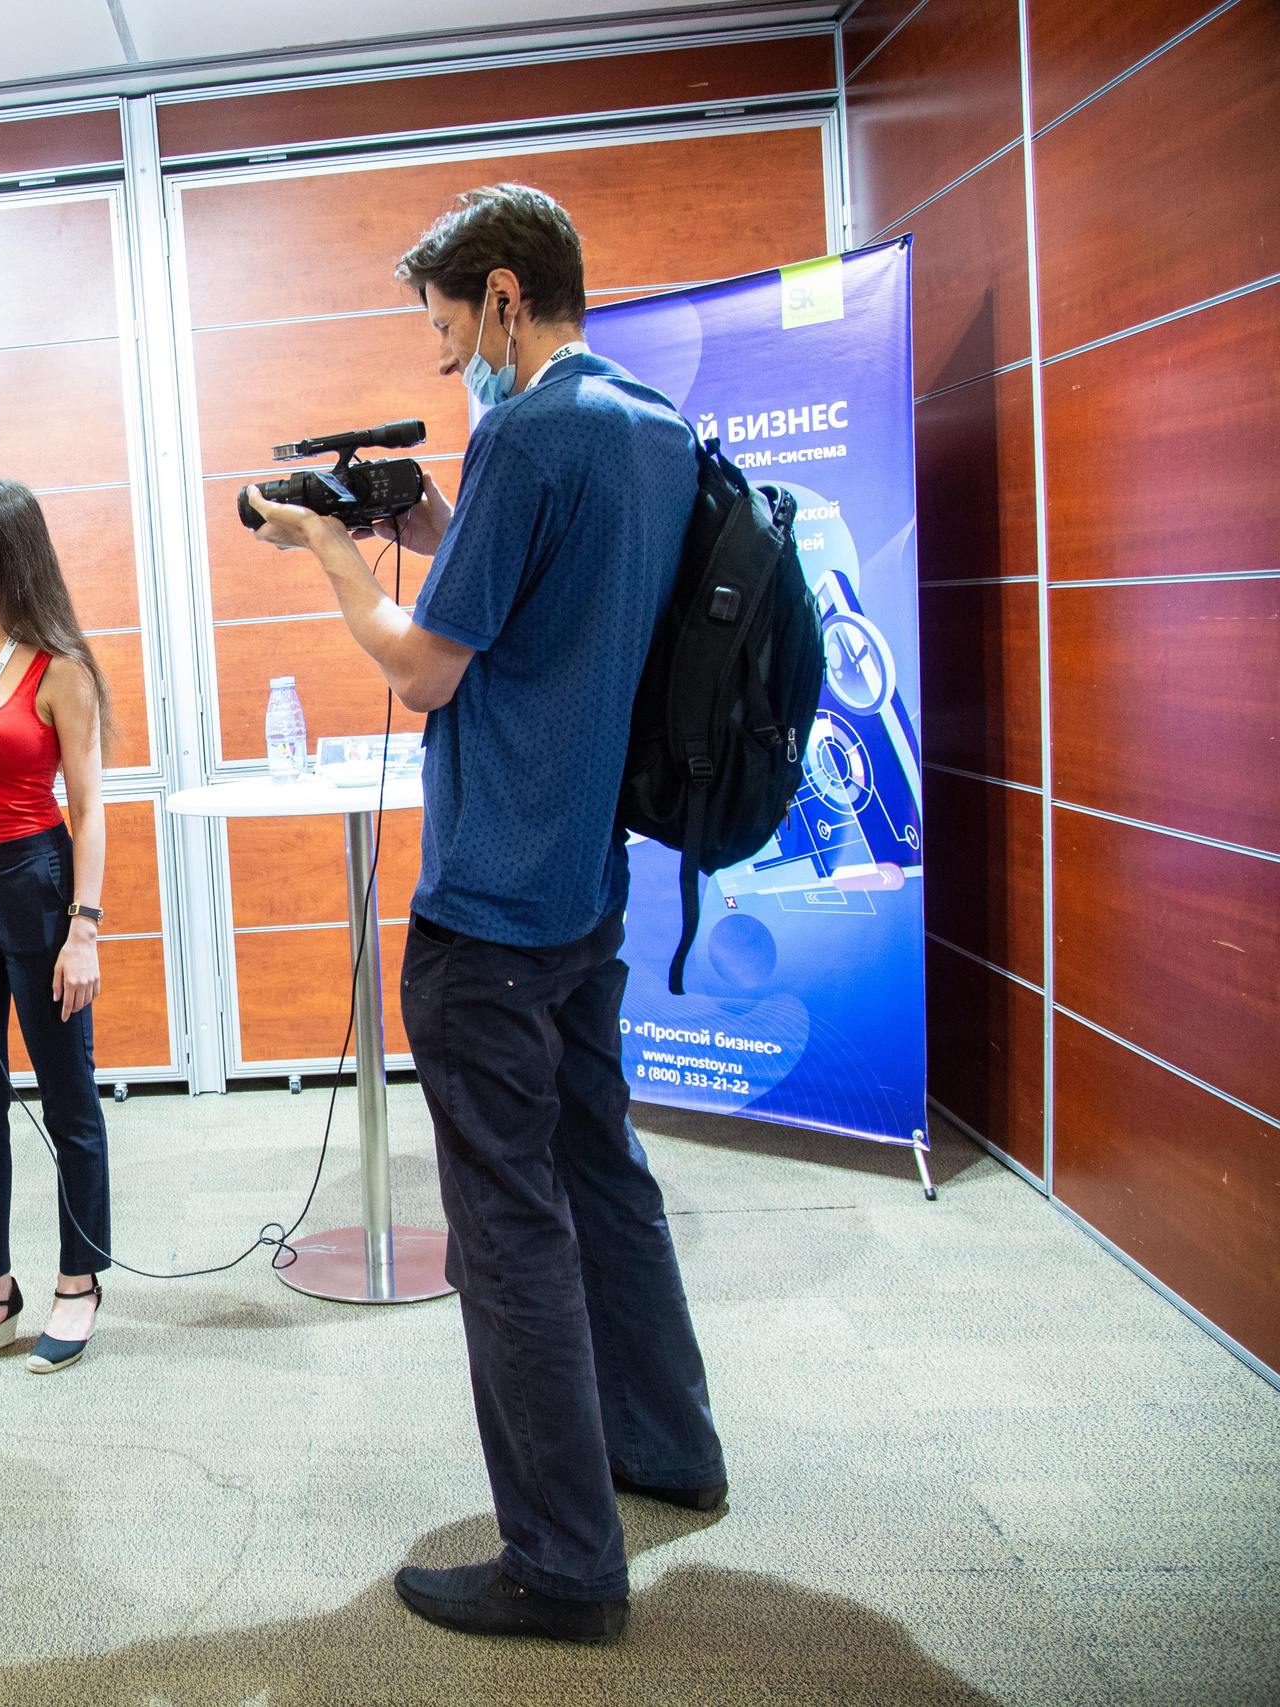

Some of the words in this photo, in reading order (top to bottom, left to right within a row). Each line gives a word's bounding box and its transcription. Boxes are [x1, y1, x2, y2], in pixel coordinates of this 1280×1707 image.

[789, 287, 816, 311] Sk
[550, 346, 573, 363] NICE
[727, 400, 849, 443] БИЗНЕС
[734, 444, 847, 470] CRM-система
[634, 1021, 711, 1046] «Простой
[714, 1032, 783, 1055] бизнес»
[642, 1050, 743, 1075] www.prostoy.ru
[636, 1064, 646, 1078] 8
[648, 1066, 681, 1085] (800)
[683, 1071, 750, 1095] 333-21-22
